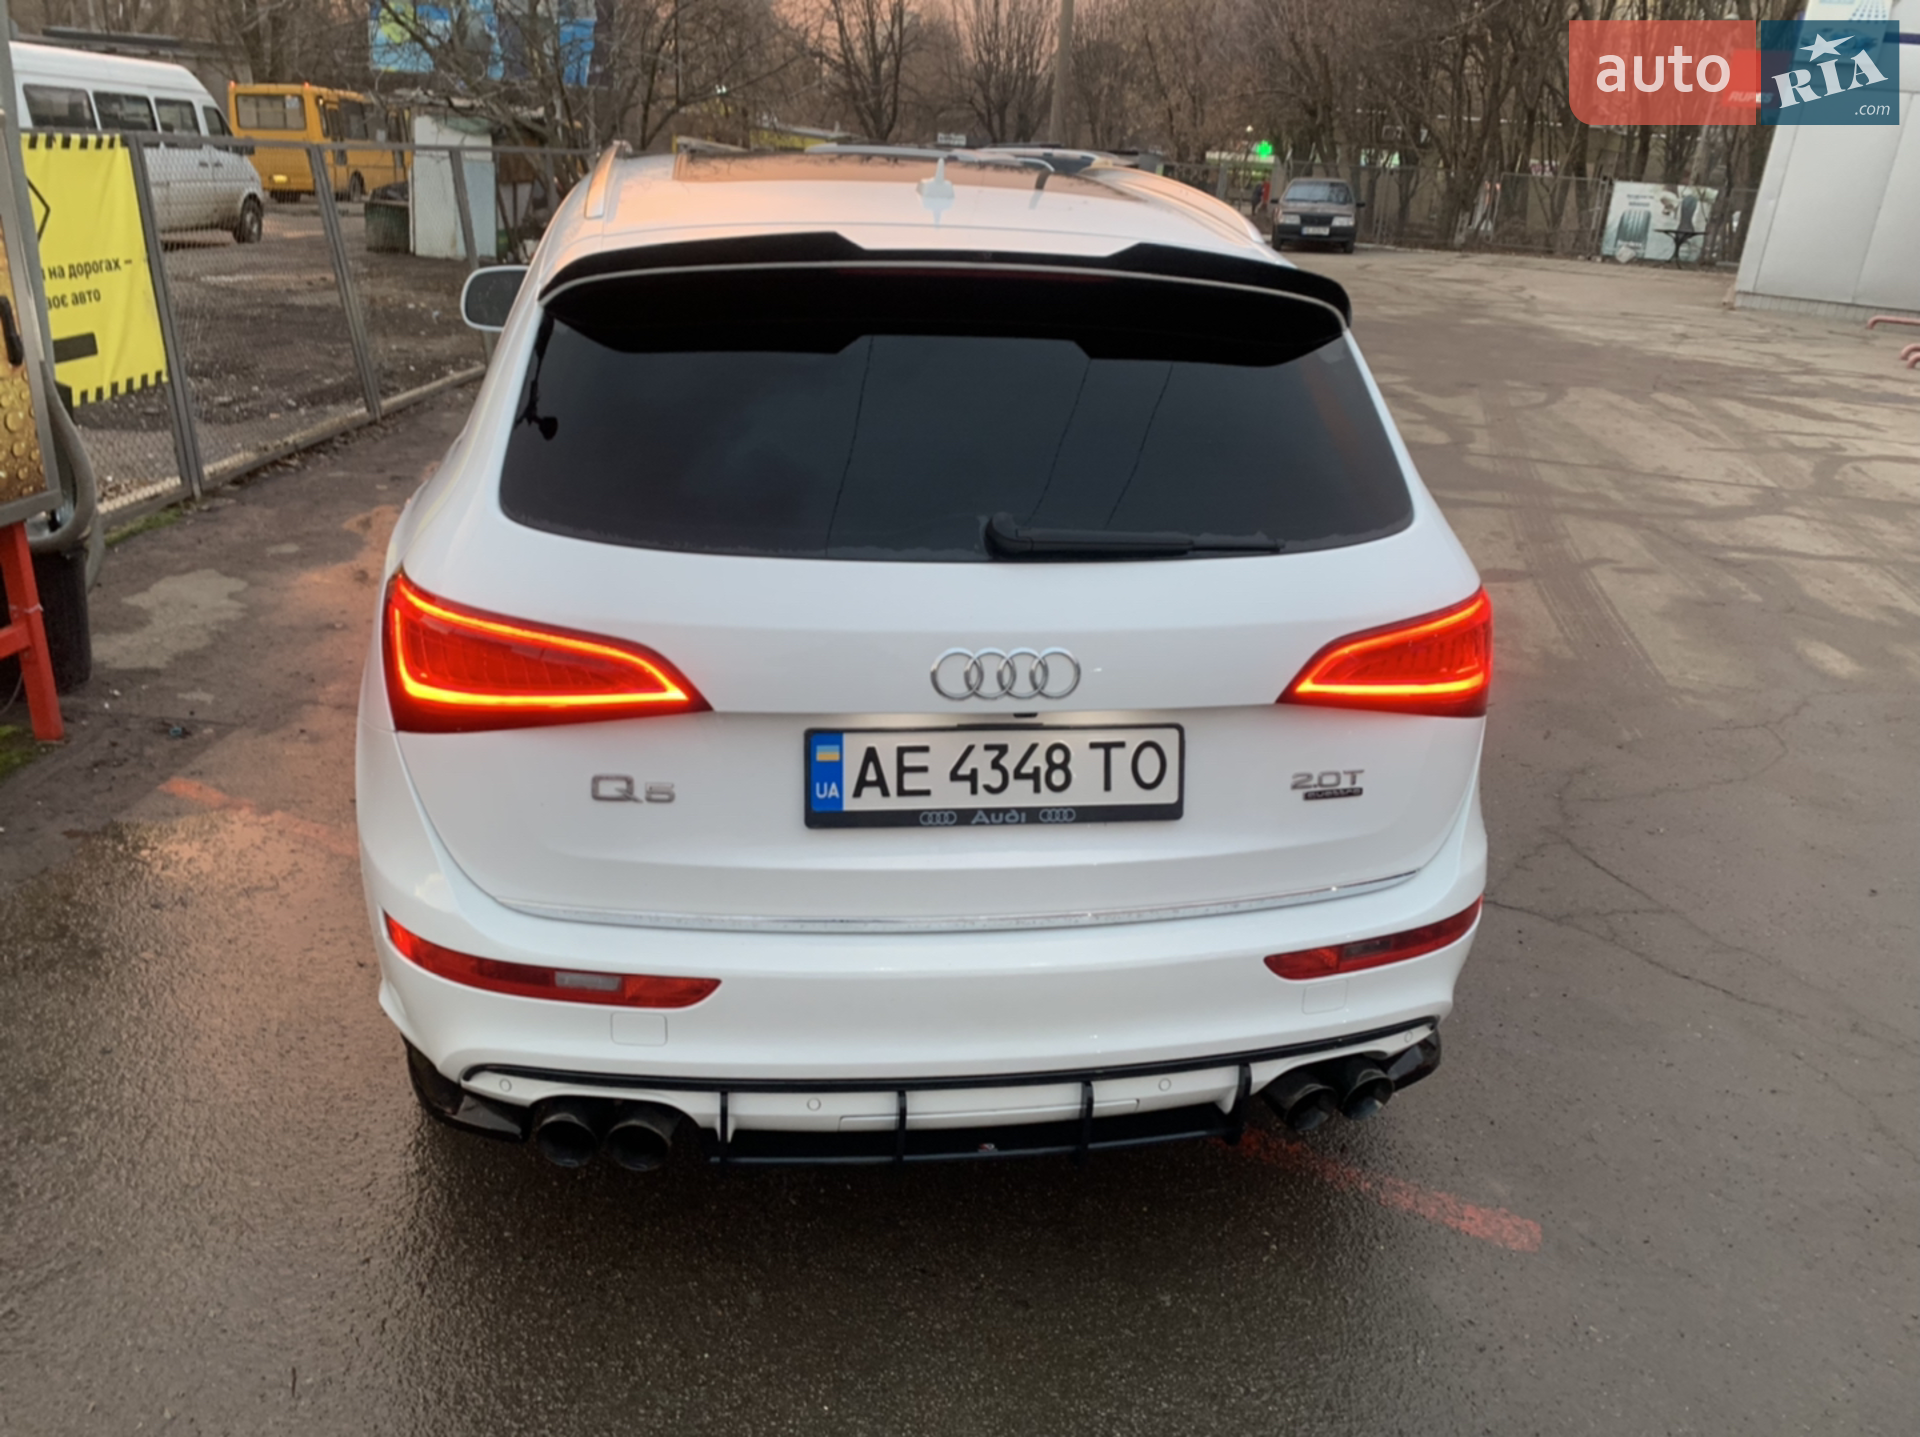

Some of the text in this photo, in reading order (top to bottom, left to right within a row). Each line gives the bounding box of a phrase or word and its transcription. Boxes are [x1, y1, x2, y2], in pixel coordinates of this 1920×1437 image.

[47, 265, 66, 280] на
[67, 257, 122, 281] дорогах
[71, 288, 101, 306] авто
[852, 740, 1168, 798] AE 4348 TO
[1290, 768, 1365, 790] 2.0T
[591, 774, 676, 804] Q5
[815, 782, 840, 799] UA
[971, 808, 1027, 826] Audi
